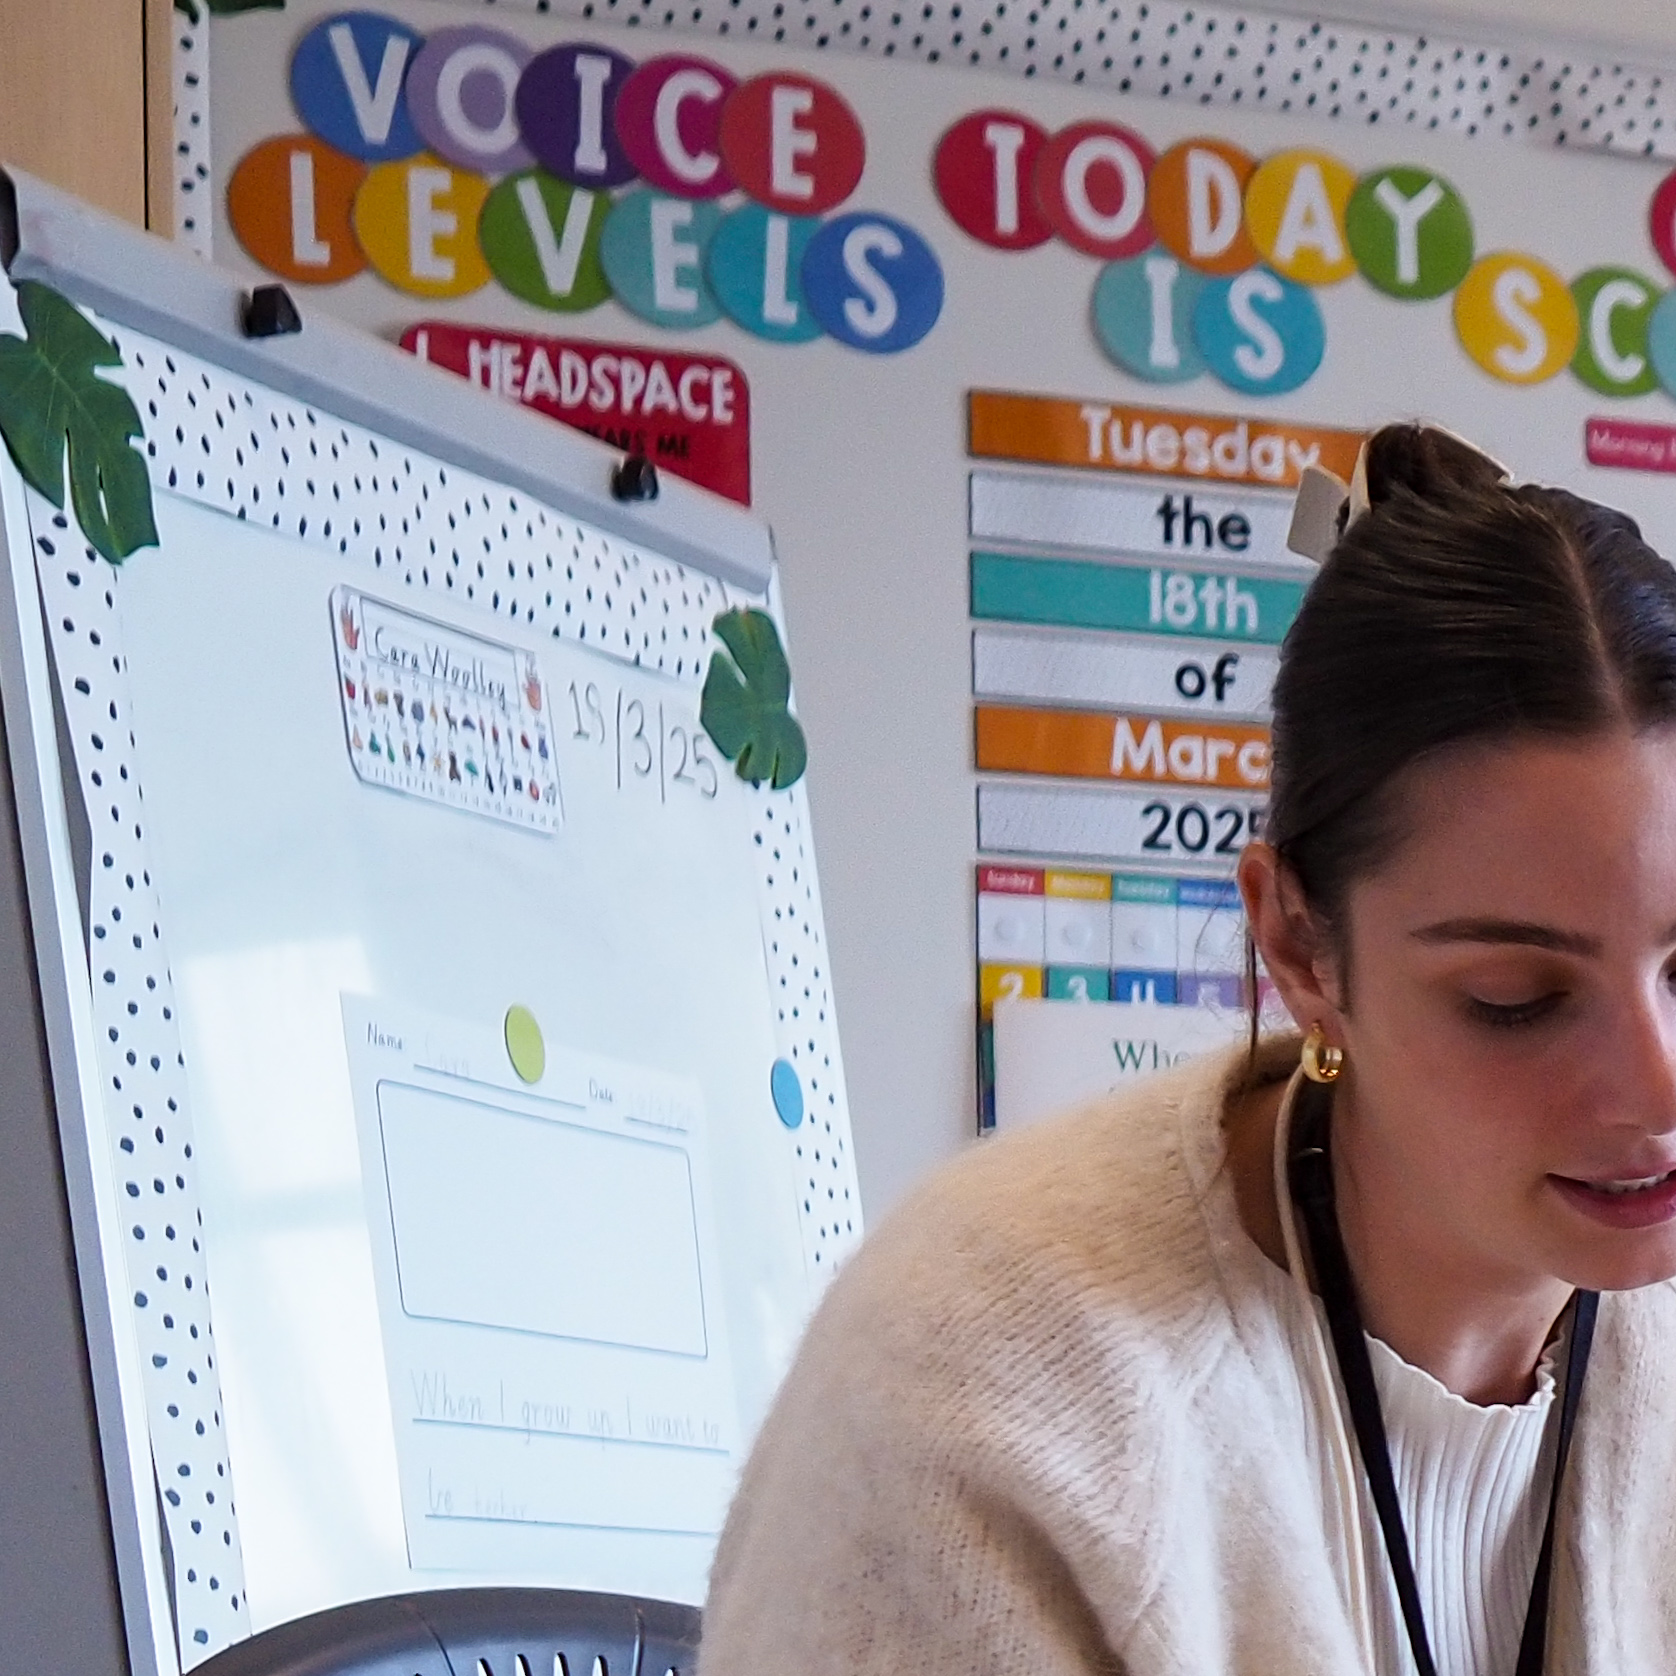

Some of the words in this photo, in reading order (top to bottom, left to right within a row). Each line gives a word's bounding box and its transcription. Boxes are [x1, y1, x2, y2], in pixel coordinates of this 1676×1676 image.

[330, 23, 817, 199] VOICE
[985, 123, 1443, 283] TODAY
[289, 151, 904, 337] LEVELS
[1145, 257, 1284, 379] IS
[468, 338, 737, 426] HEADSPACE
[1081, 406, 1322, 481] Tuesday
[1157, 494, 1251, 550] the
[1148, 568, 1260, 633] 18th
[375, 626, 420, 669] Cara
[1174, 652, 1240, 701] of
[1110, 716, 1272, 782] Marc
